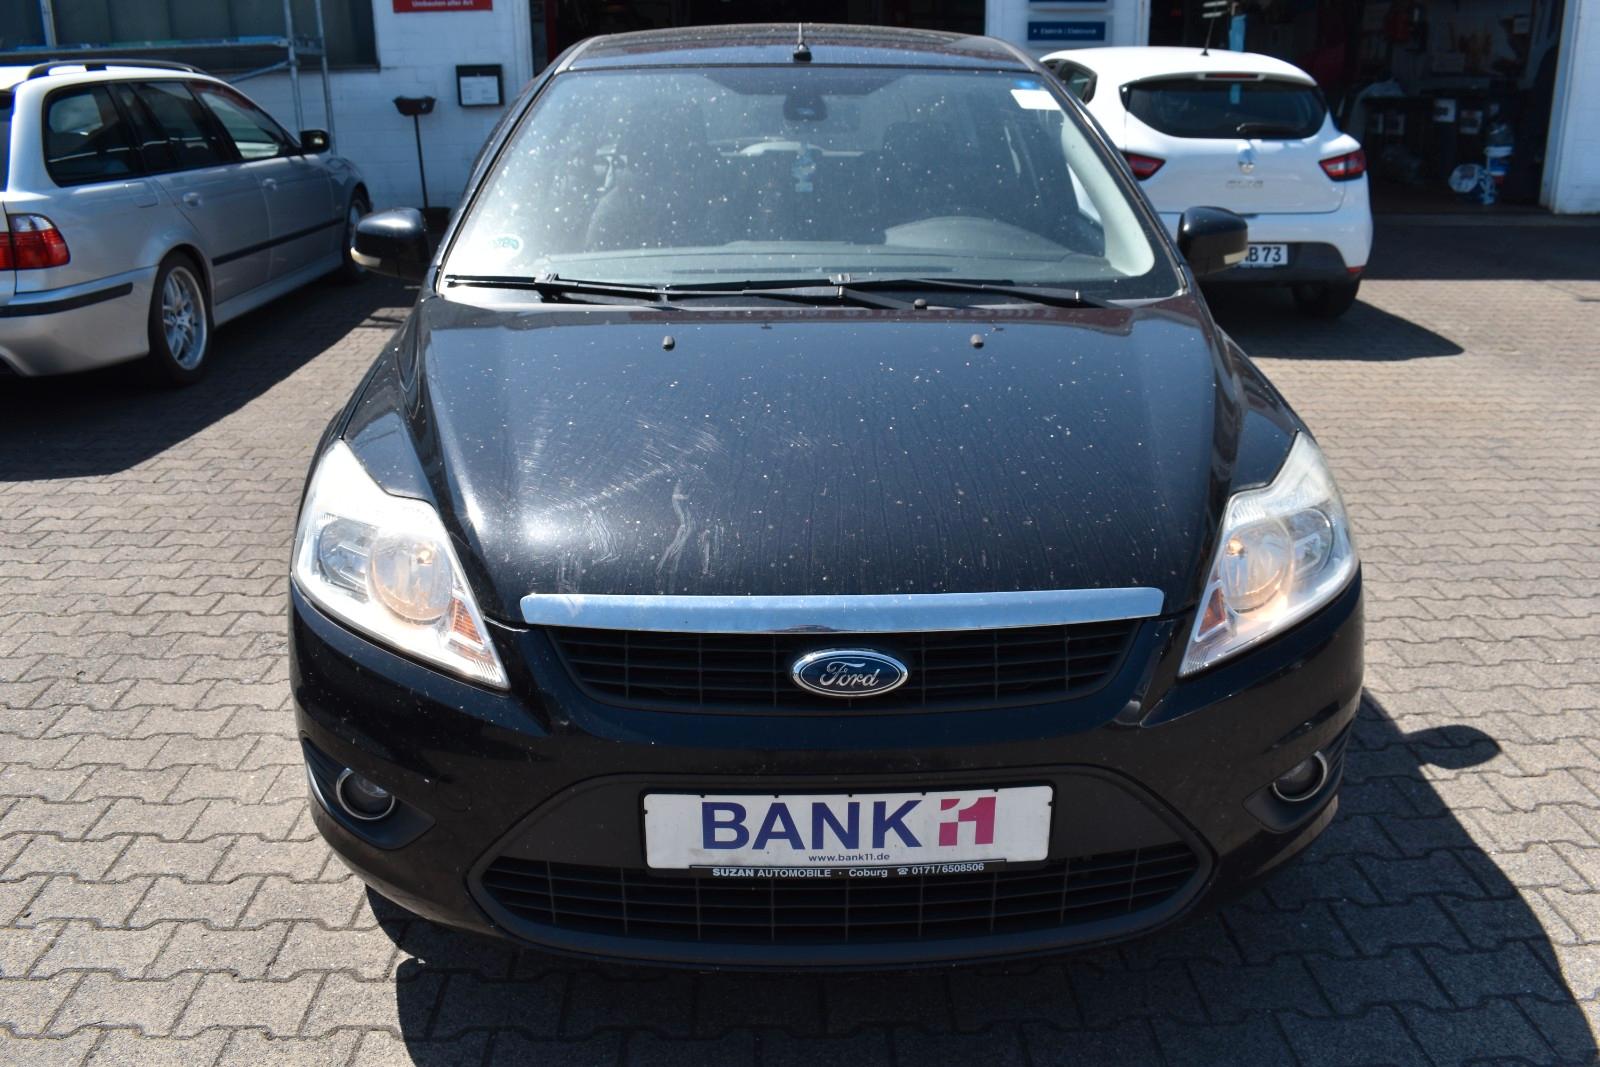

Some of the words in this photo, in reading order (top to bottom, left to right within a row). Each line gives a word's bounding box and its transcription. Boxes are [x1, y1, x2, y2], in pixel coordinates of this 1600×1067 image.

[1245, 246, 1259, 263] B
[1262, 246, 1281, 263] 73
[819, 661, 881, 688] Ford
[808, 852, 891, 863] www.bank11.de
[712, 868, 754, 877] SUZAN
[757, 868, 832, 878] AUTOMOBILE
[848, 867, 888, 878] Coburg
[911, 862, 985, 876] 0171/6508506
